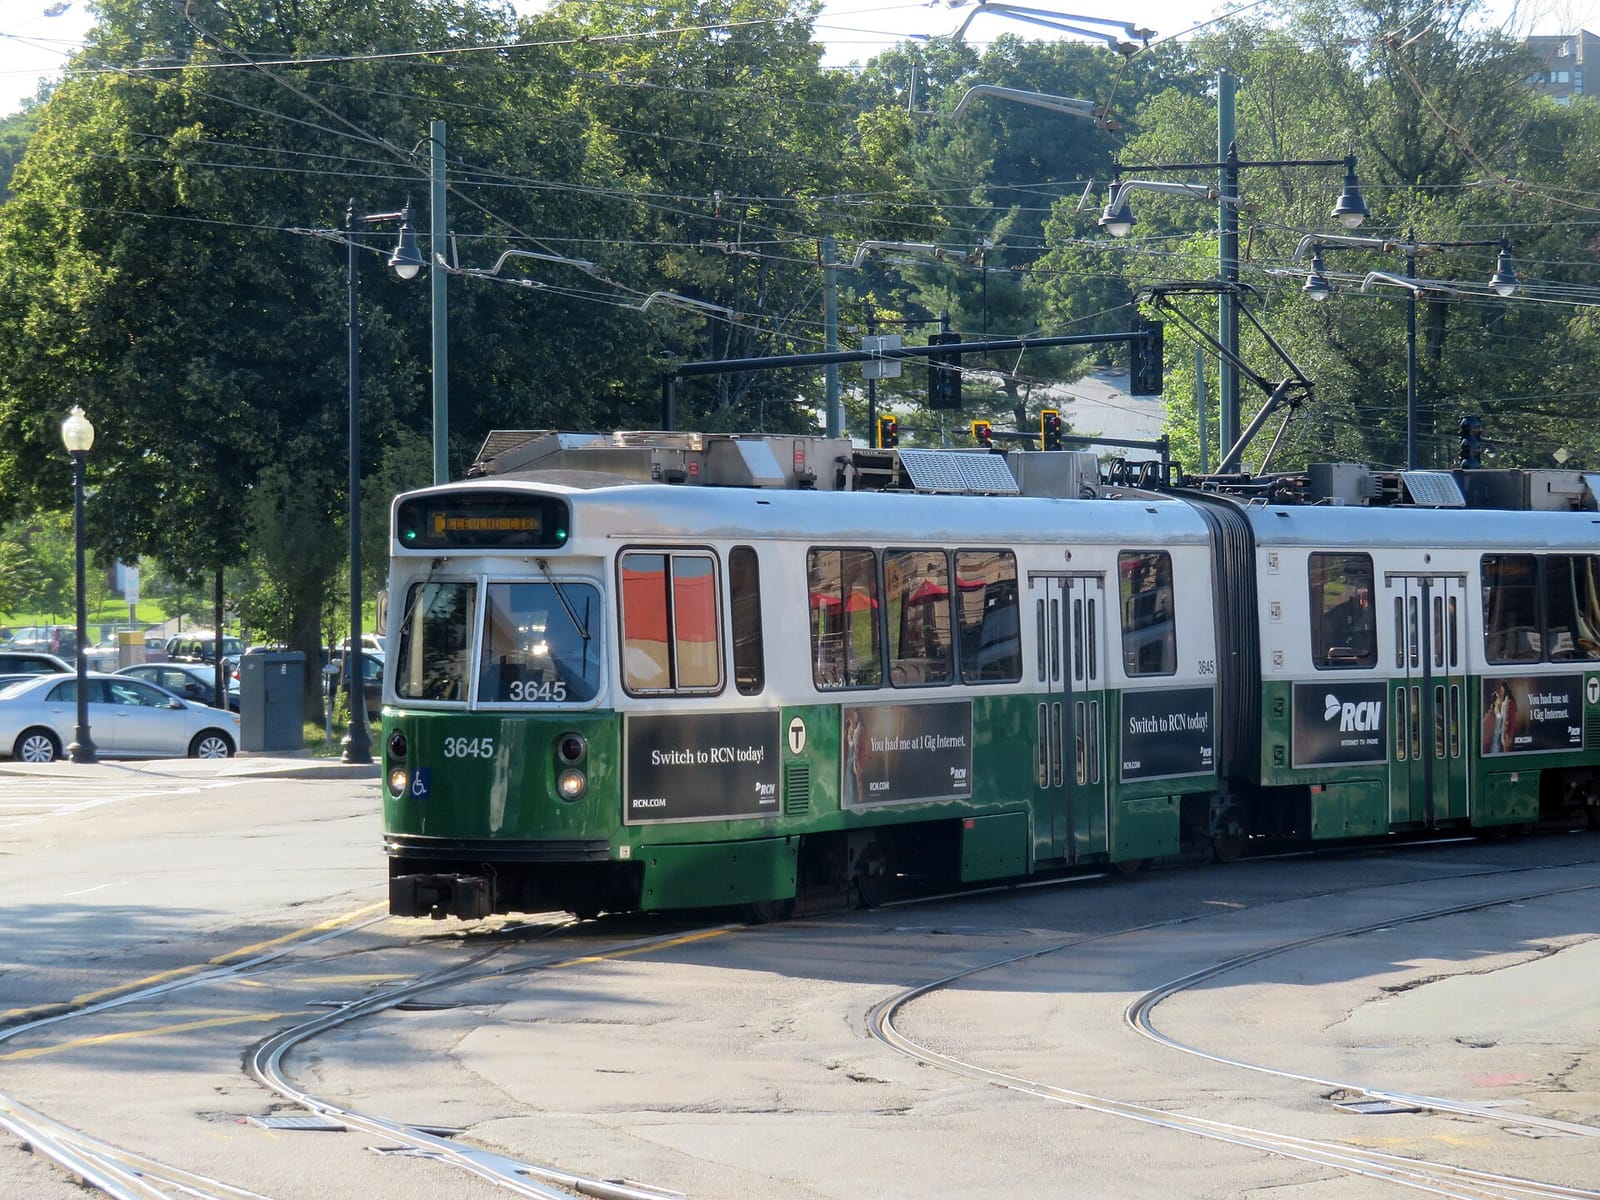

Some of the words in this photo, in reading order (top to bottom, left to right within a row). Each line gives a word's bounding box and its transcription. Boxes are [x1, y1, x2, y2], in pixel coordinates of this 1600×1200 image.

[1198, 660, 1214, 674] 3645
[509, 680, 566, 701] 3645
[1528, 693, 1539, 705] You
[1540, 692, 1551, 704] had
[1552, 695, 1561, 704] me
[1129, 715, 1158, 734] Switch
[1160, 717, 1167, 732] to
[1169, 713, 1186, 731] RCN
[1187, 711, 1208, 733] today!
[1339, 701, 1381, 732] RCN
[1534, 708, 1544, 722] Gig
[791, 726, 803, 749] T
[871, 737, 884, 751] You
[885, 736, 898, 751] had
[900, 739, 910, 750] me
[911, 738, 919, 750] at
[924, 734, 935, 752] Gig
[936, 734, 965, 748] Internet.
[444, 737, 494, 758] 3645
[652, 747, 694, 765] Switch
[697, 750, 708, 764] to
[710, 747, 735, 763] RCN
[737, 745, 764, 764] today!
[760, 783, 775, 795] RCN
[632, 799, 666, 808] RCN.COM
